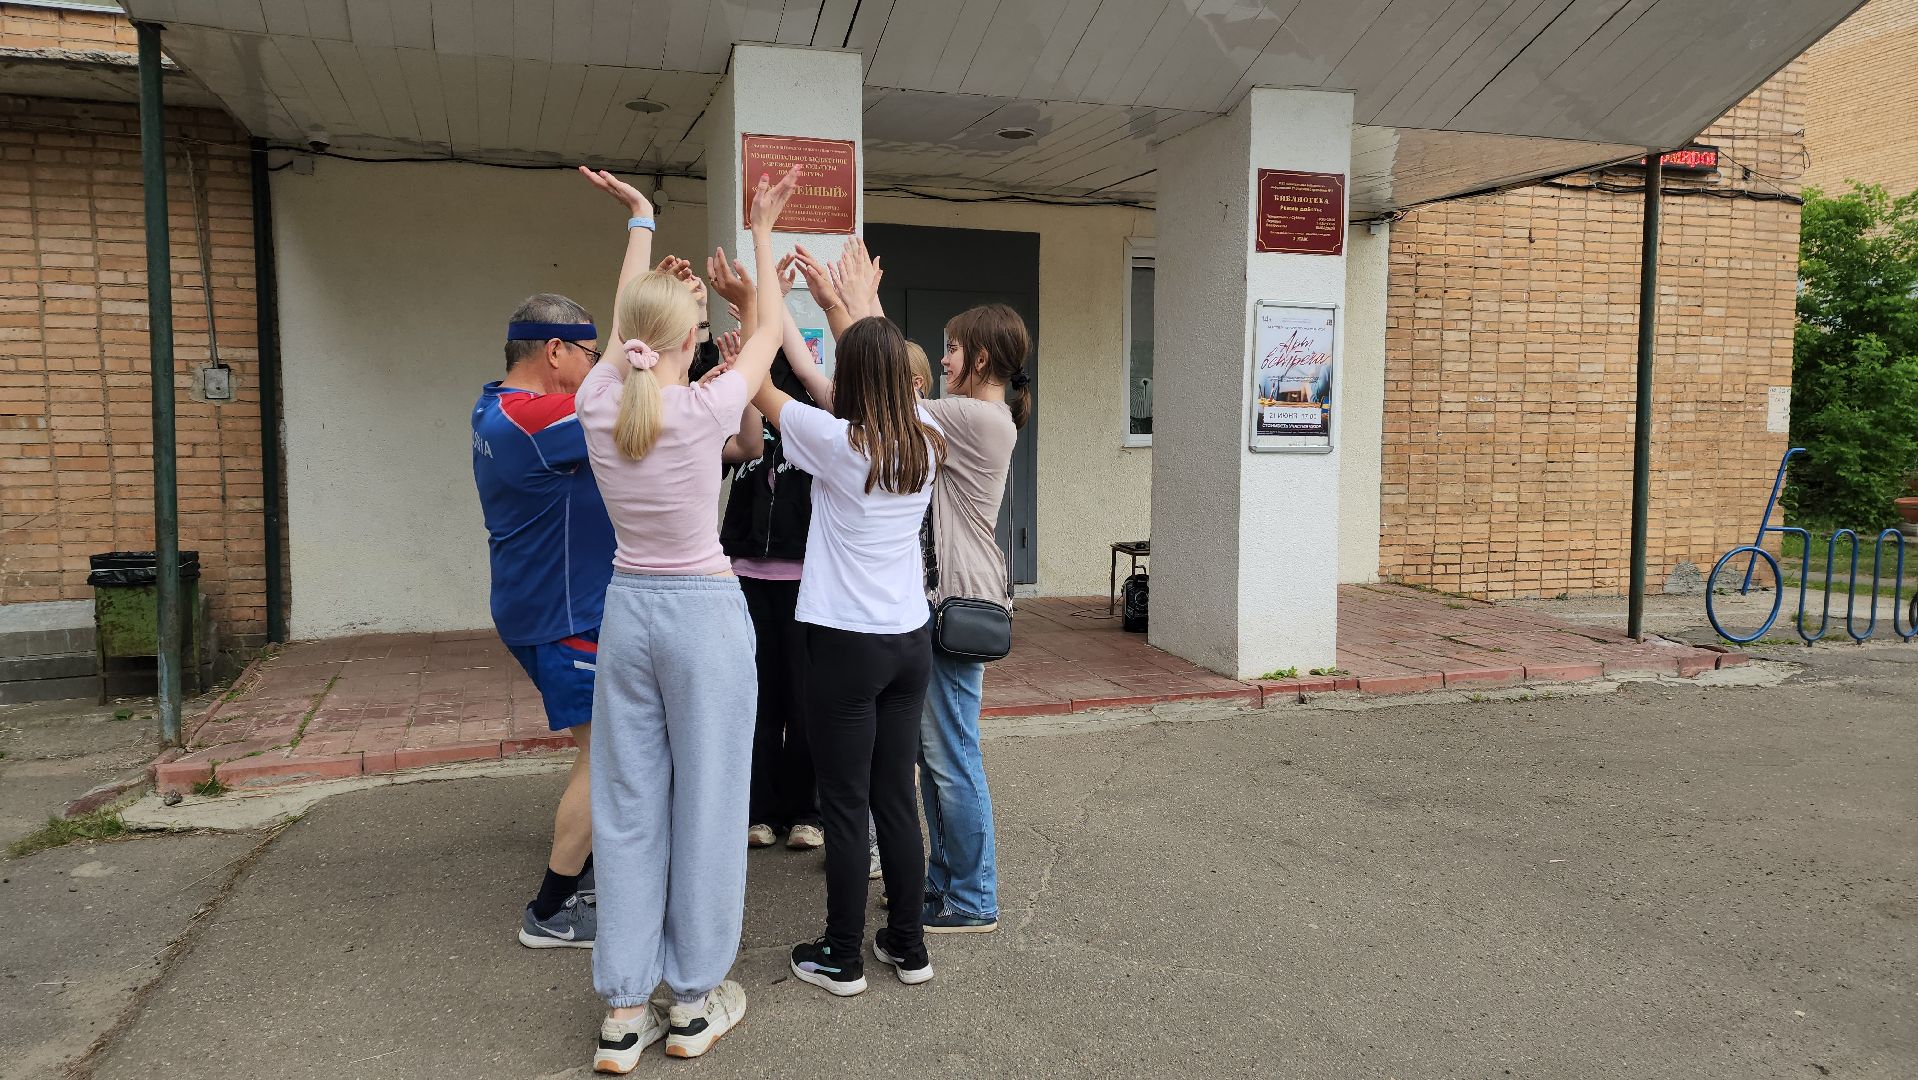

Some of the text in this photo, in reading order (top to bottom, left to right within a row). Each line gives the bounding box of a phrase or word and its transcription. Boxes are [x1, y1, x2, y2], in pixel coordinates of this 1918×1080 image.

[762, 161, 804, 169] УЧРЕЖДЕЕ
[751, 184, 848, 198] «ЕЙНЫЙ»
[1273, 194, 1330, 205] БИБЛИОТЕКА
